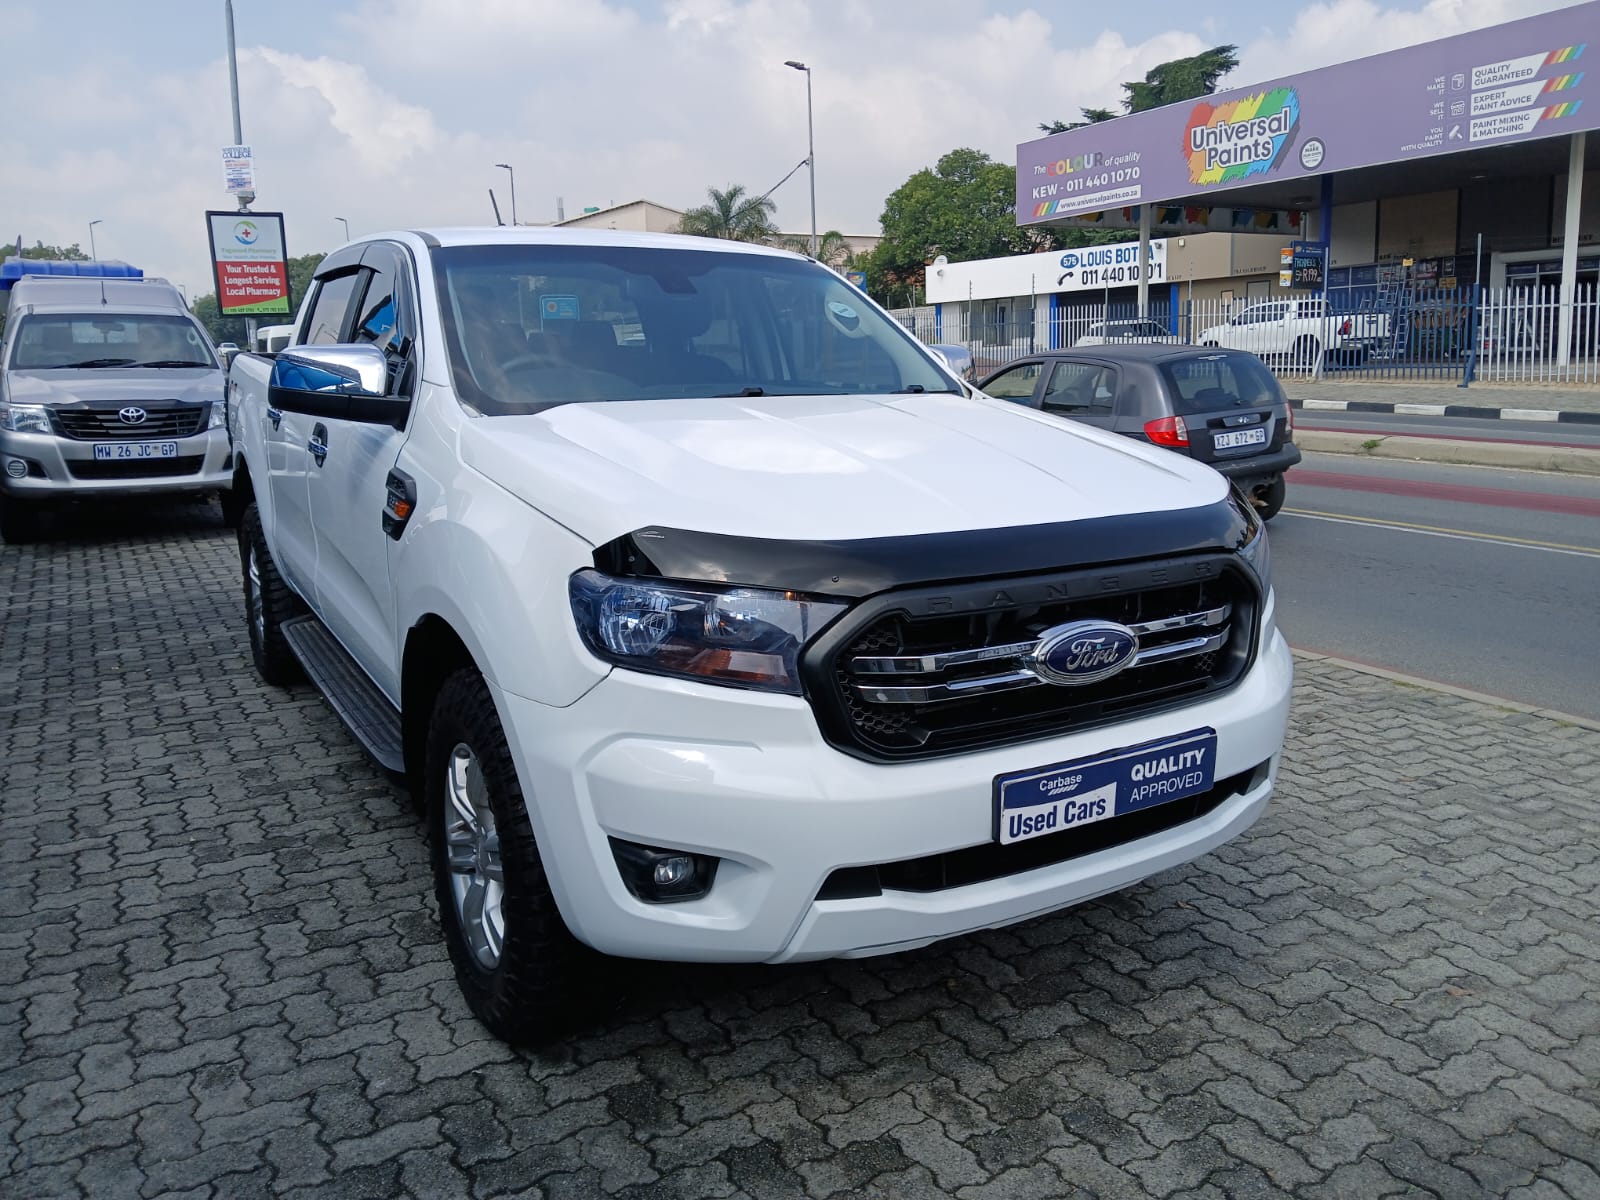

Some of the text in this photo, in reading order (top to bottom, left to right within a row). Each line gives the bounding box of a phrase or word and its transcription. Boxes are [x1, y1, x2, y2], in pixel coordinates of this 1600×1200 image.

[1474, 68, 1533, 86] GUARANTEED
[1475, 64, 1511, 78] QUALITY
[1427, 82, 1445, 90] MAKE
[1473, 91, 1506, 104] EXPERT
[1473, 95, 1532, 112] PAINT ADVICE
[1430, 107, 1445, 115] SELL
[1192, 109, 1289, 150] Universal
[1472, 113, 1530, 130] PAINT MIXING
[1479, 123, 1524, 137] MATCHING
[1400, 139, 1443, 152] WITH QUALITY
[1424, 133, 1443, 141] PAINT
[1207, 139, 1272, 168] Paints
[1034, 151, 1141, 176] The COLOUR of quality
[1032, 183, 1058, 199] KEW
[1066, 178, 1083, 192] 011
[1086, 172, 1109, 188] 440
[1111, 166, 1140, 183] 1070
[1060, 190, 1138, 208] www.universalpaints.co.za
[1063, 245, 1154, 268] 575 LOUIS BOTA
[225, 264, 276, 273] Your Trusted &
[1081, 269, 1098, 285] 011
[1101, 267, 1124, 282] 440
[224, 276, 281, 286] Longest Serving
[226, 287, 281, 297] Local Pharmacy
[1235, 432, 1248, 445] 672
[96, 444, 175, 457] MW 26 JC GP
[927, 561, 1212, 612] RANGER
[1065, 637, 1119, 670] Ford
[1131, 747, 1206, 781] QUALITY
[1039, 774, 1082, 791] Carbase
[1129, 771, 1204, 803] APPROVED
[1008, 797, 1107, 838] Used Cars
